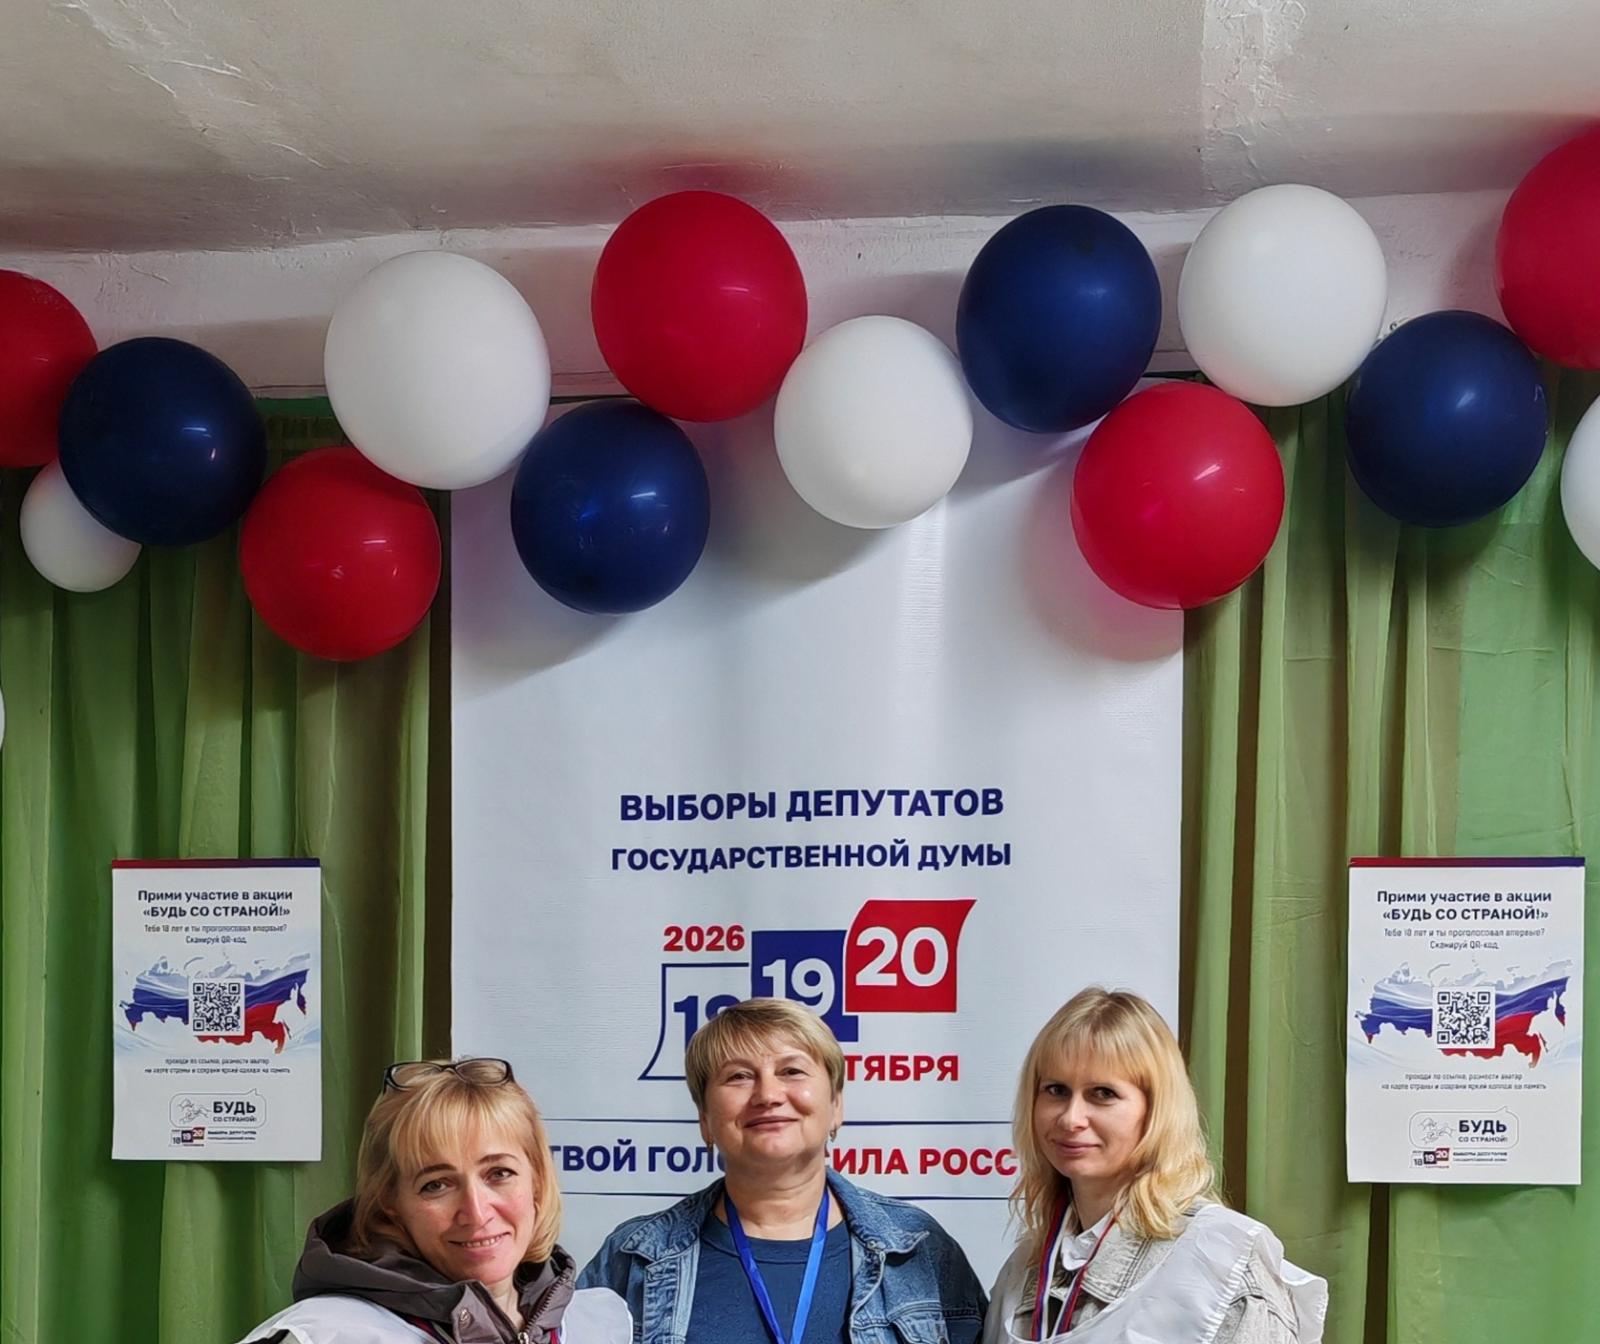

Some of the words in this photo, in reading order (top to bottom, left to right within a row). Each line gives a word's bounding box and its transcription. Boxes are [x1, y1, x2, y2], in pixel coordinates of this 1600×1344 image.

[620, 791, 776, 821] ВЫБОРЫ
[786, 788, 1004, 822] ДЕПУТАТОВ
[611, 839, 909, 873] ГОСУДАРСТВЕННОЙ
[917, 842, 1012, 871] ДУМЫ
[138, 890, 182, 903] Прими
[185, 891, 239, 903] участие
[242, 891, 250, 901] в
[253, 891, 293, 902] акции
[1377, 890, 1426, 905] Прими
[1430, 892, 1490, 905] участие
[1494, 892, 1503, 902] в
[1506, 891, 1552, 903] акции
[143, 906, 187, 918] «БУДЬ
[190, 906, 210, 917] СО
[213, 903, 290, 917] СТРАНОЙ!»
[1383, 908, 1432, 921] «БУДЬ
[1435, 908, 1457, 920] СО
[1461, 905, 1549, 920] СТРАНОЙ!»
[663, 925, 745, 952] 2026
[762, 957, 835, 1016] 19
[855, 926, 949, 987] 20
[844, 1054, 959, 1082] ТЯБРЯ
[213, 1101, 257, 1115] БУДЬ
[1459, 1119, 1507, 1135] БУДЬ
[648, 1146, 726, 1173] ГОЛ
[825, 1148, 909, 1175] ИЛА
[919, 1148, 1018, 1176] РОСС
